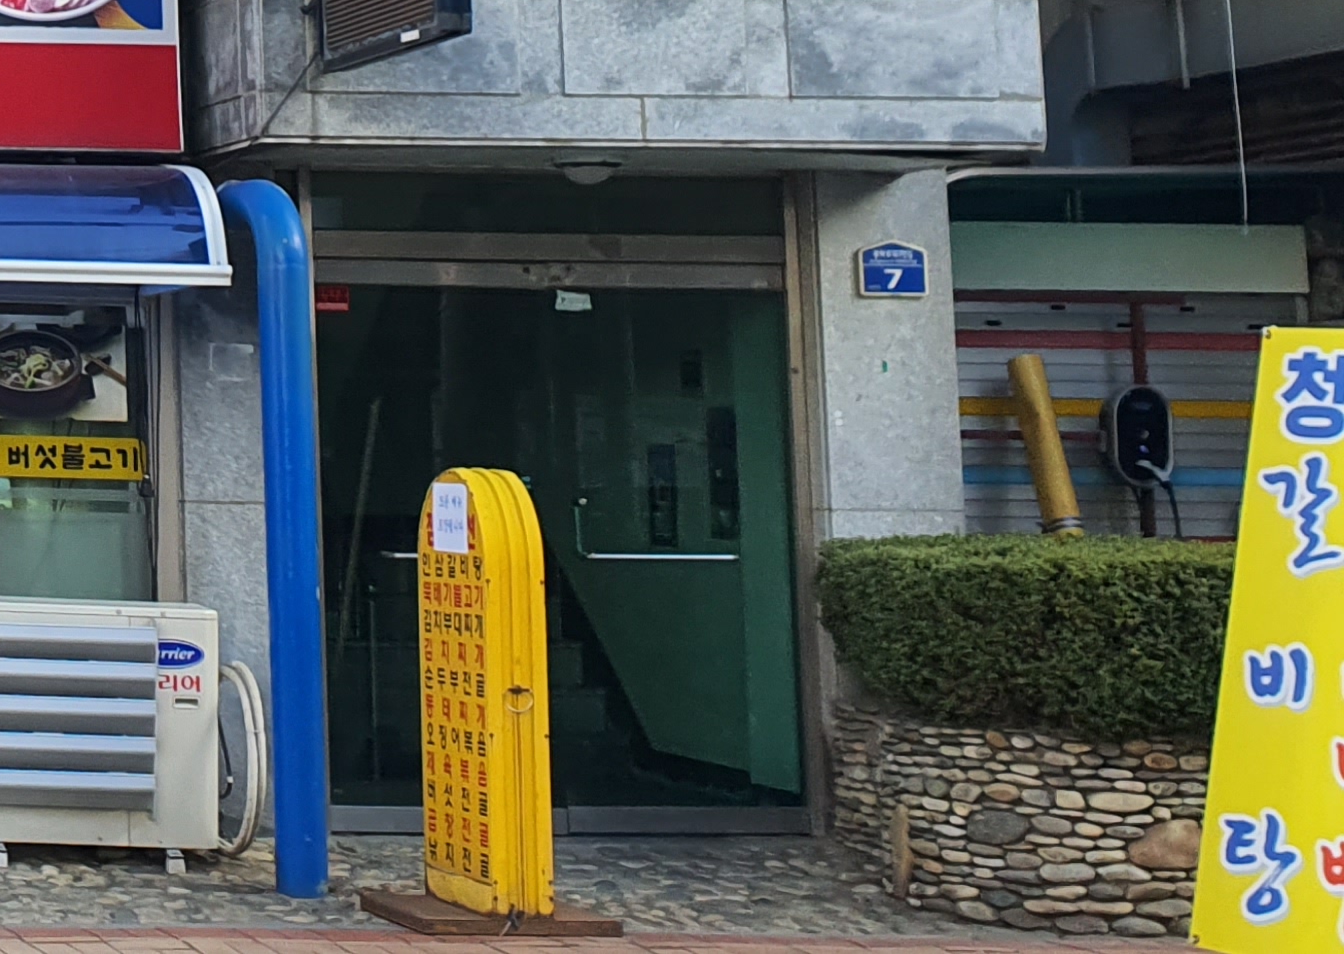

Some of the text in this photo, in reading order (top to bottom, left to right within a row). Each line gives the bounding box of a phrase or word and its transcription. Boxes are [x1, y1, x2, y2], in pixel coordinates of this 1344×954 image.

[883, 268, 904, 290] 7
[7, 442, 140, 473] 버섯불고기
[421, 552, 484, 582] 인삼갈비탕
[423, 608, 485, 640] 김치부대찌개
[159, 646, 196, 661] rrier
[423, 636, 486, 670] 김치찌개
[158, 673, 202, 693] 리어
[424, 664, 487, 699] 순두부전골
[424, 692, 488, 731] 동태찌개
[426, 720, 488, 758] 오징어볶음
[426, 750, 488, 788] 제육볶음
[427, 779, 489, 818] 버섯전골
[428, 807, 490, 849] 곱창전골
